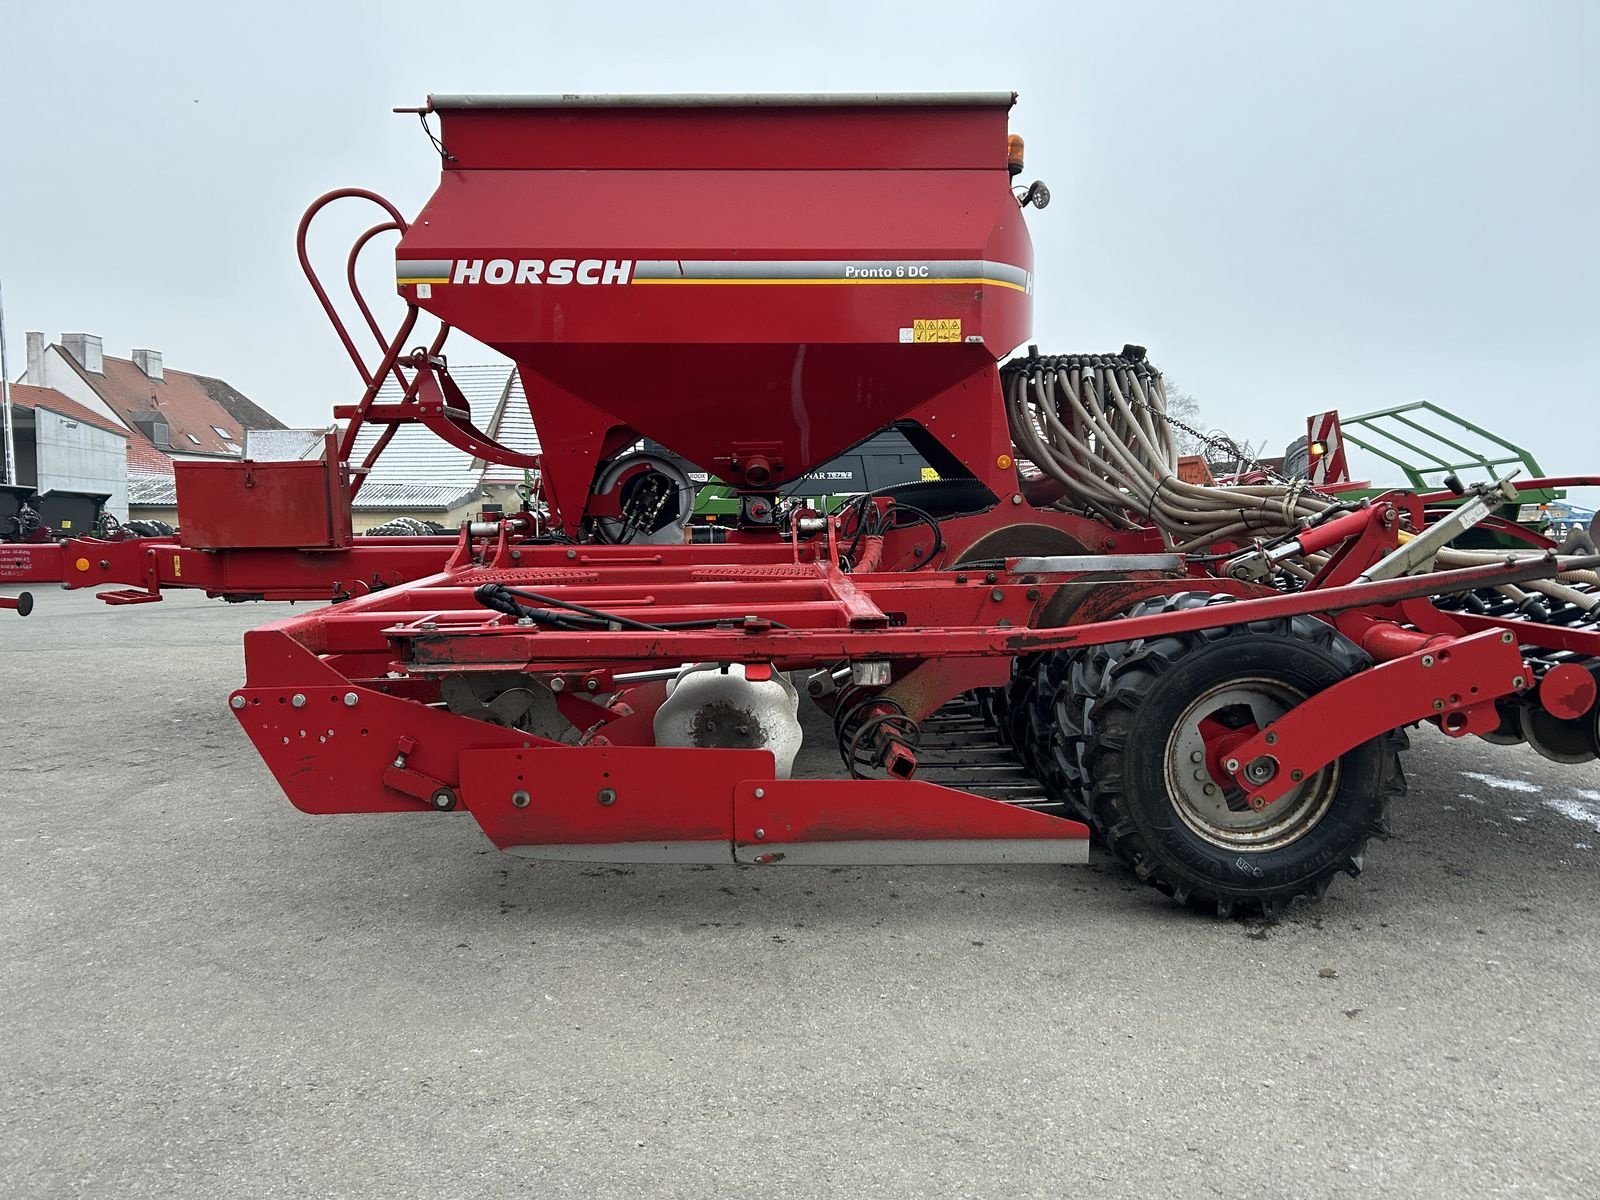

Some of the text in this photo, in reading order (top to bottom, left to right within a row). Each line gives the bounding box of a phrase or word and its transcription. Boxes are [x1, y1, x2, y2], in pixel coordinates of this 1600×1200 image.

[453, 259, 632, 285] HORSCH
[845, 266, 929, 278] Pronto 6 DC
